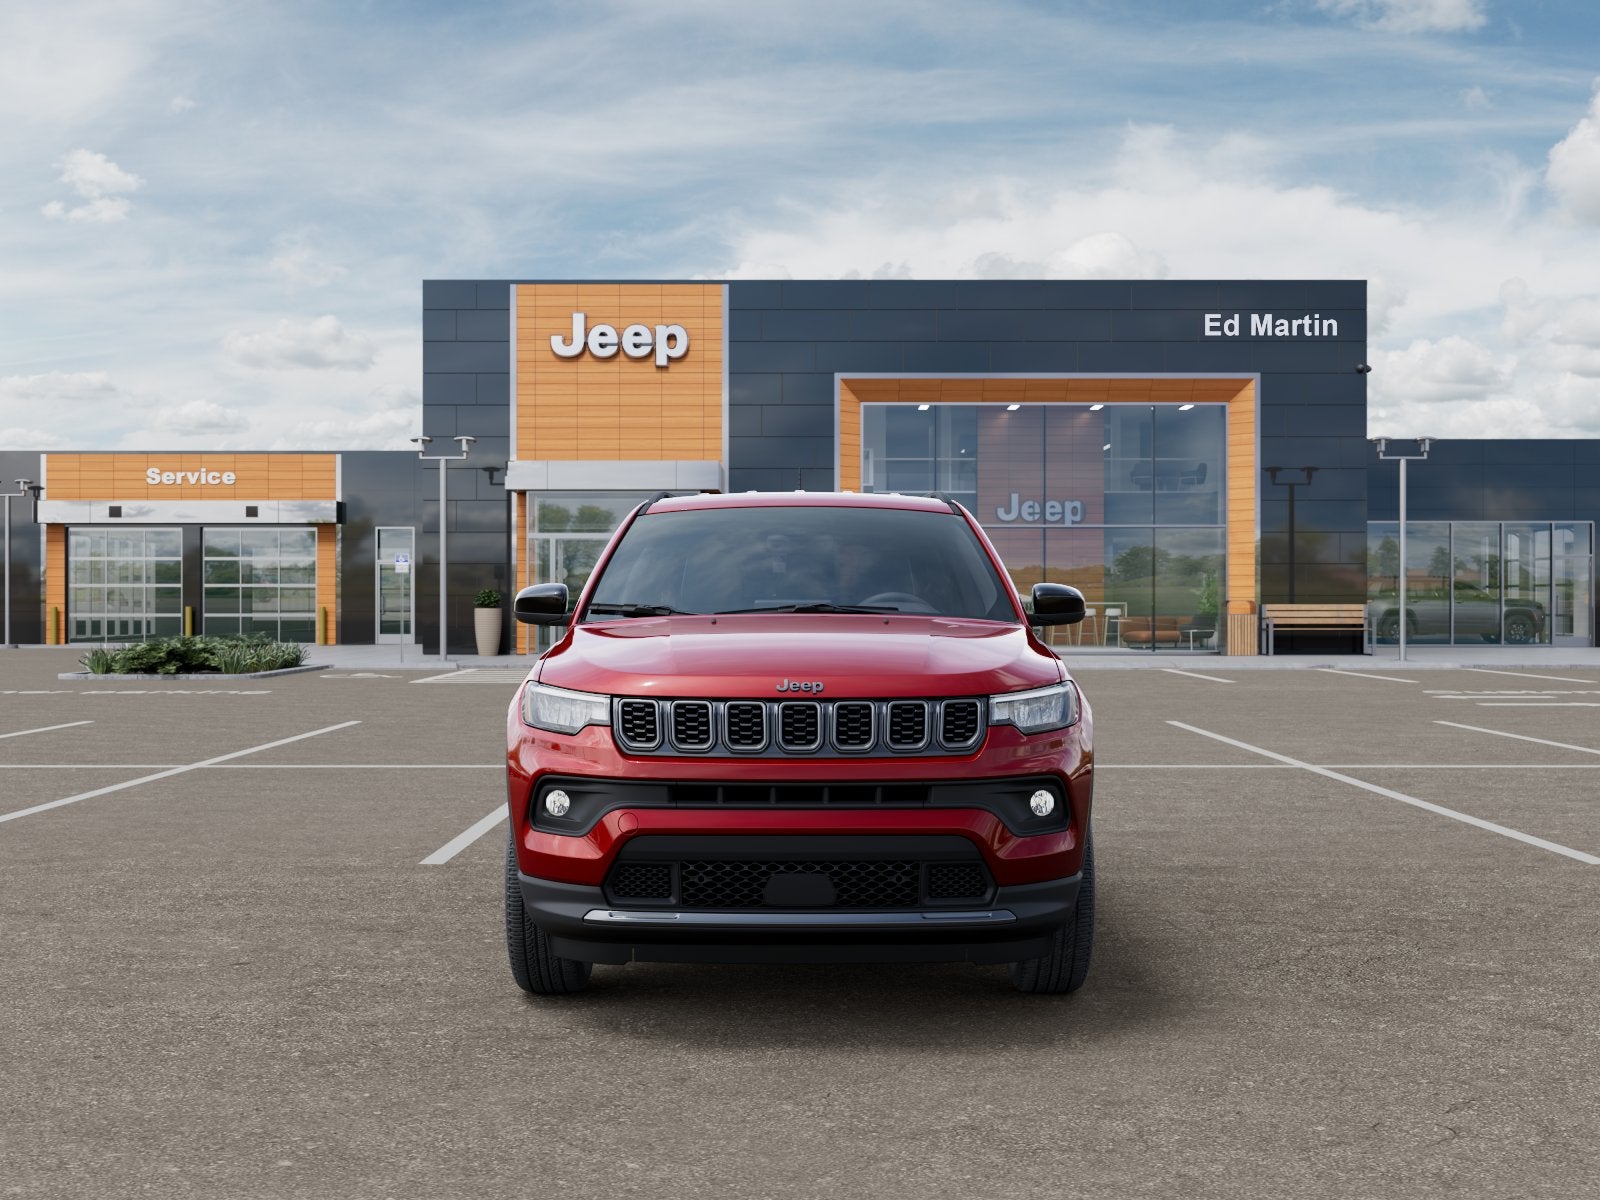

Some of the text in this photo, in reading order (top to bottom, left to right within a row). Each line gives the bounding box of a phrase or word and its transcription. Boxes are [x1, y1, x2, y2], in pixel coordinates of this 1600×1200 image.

[1204, 313, 1338, 337] Ed Martin
[550, 312, 689, 367] Jeep
[146, 467, 236, 485] Service
[996, 493, 1084, 526] Jeep
[776, 678, 824, 694] Jeep
